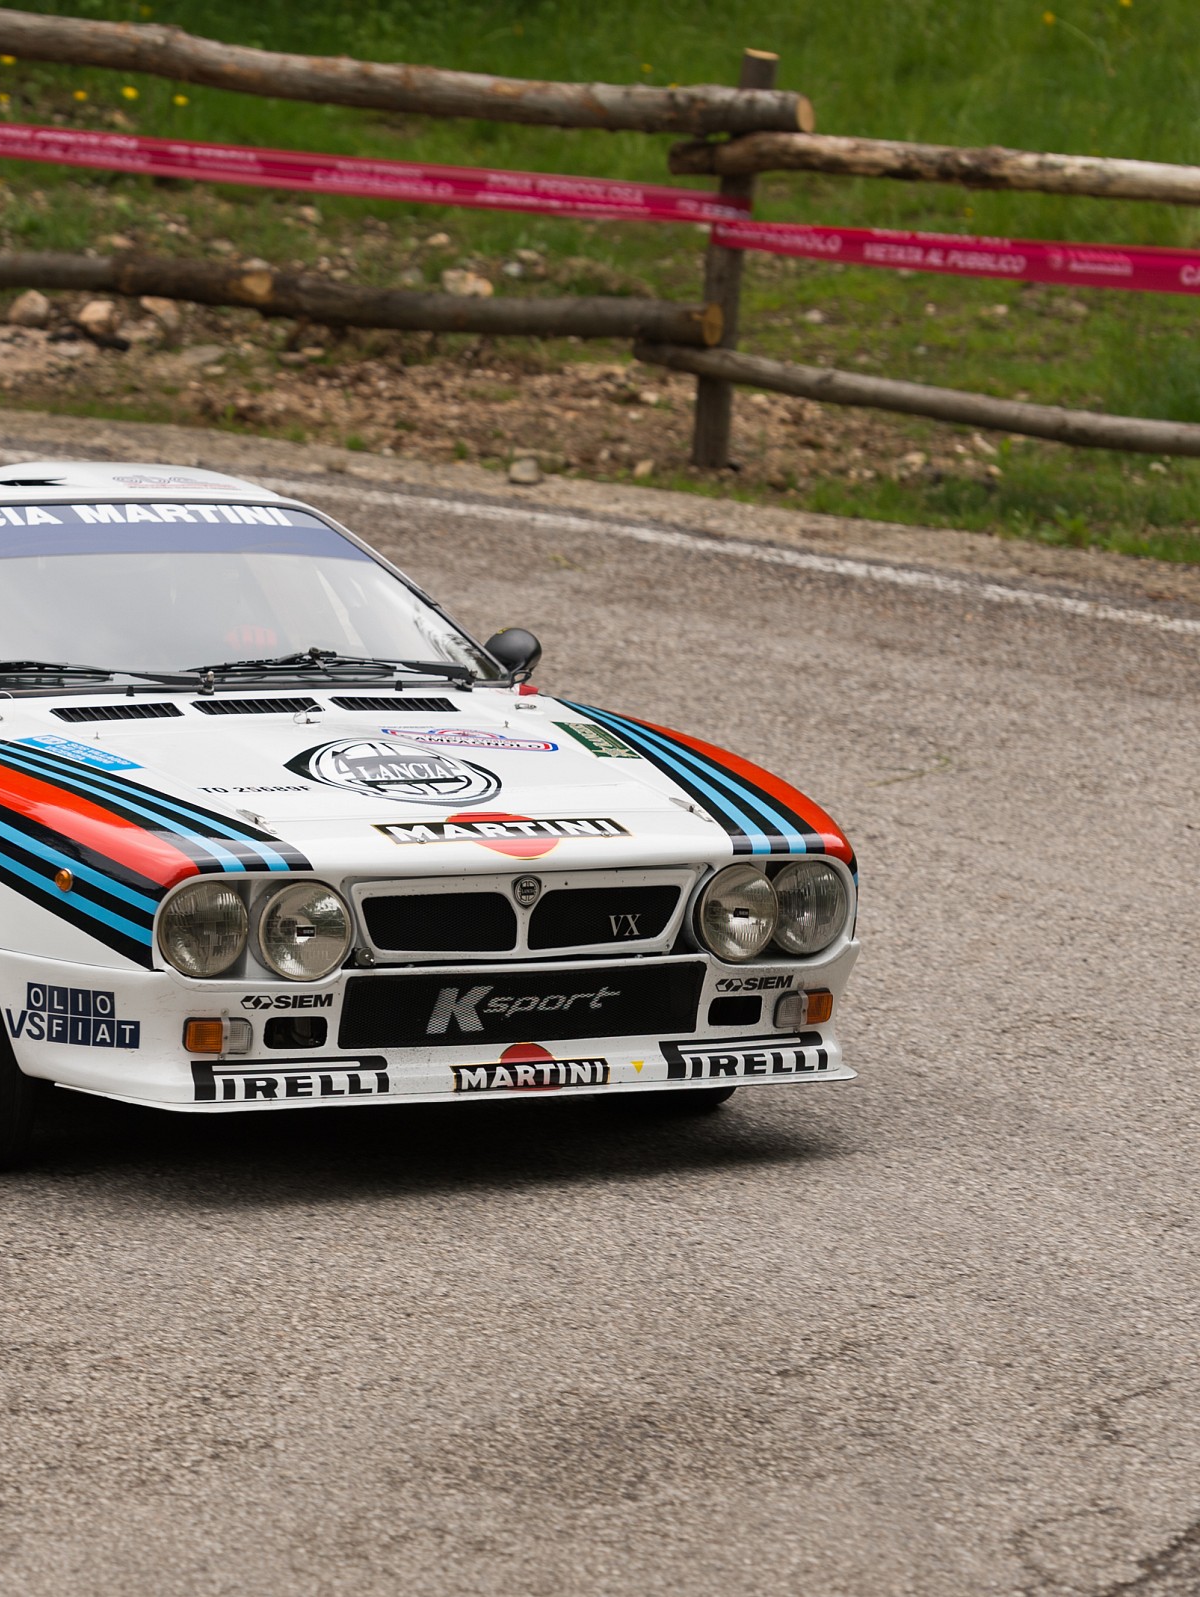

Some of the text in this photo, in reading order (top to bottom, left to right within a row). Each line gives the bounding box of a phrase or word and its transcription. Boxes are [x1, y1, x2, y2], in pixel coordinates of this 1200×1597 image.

[70, 503, 294, 528] MARTINI
[356, 762, 455, 780] LANCIA
[392, 818, 616, 844] MARTINI
[608, 914, 642, 937] VX
[745, 976, 794, 990] SIEM
[30, 986, 112, 1014] OLIO
[274, 994, 333, 1009] SIEM
[5, 1009, 135, 1046] VS FIAT
[659, 1032, 829, 1081] PIRELLI
[191, 1055, 390, 1101] PIRELLI
[459, 1060, 606, 1091] MARTINI
